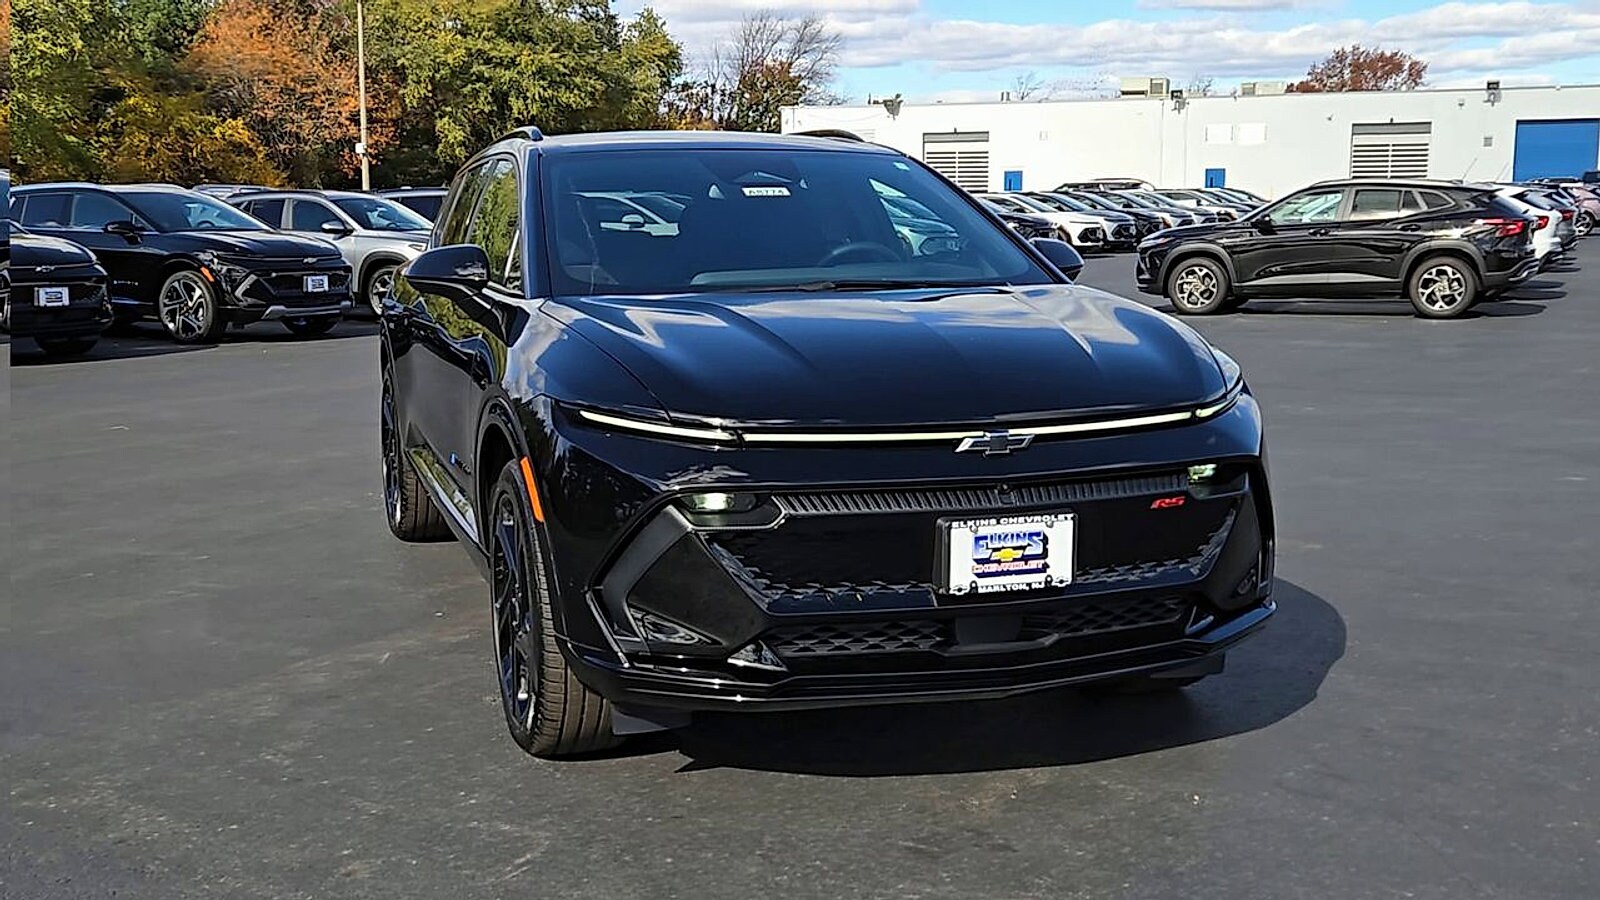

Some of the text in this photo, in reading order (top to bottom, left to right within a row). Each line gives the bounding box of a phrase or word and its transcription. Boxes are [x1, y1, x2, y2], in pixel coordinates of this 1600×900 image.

[1150, 496, 1185, 509] RS
[952, 513, 1074, 529] ELKINS CHEVROLET
[972, 531, 1046, 558] ELKINS
[978, 583, 1029, 593] MARLTON,
